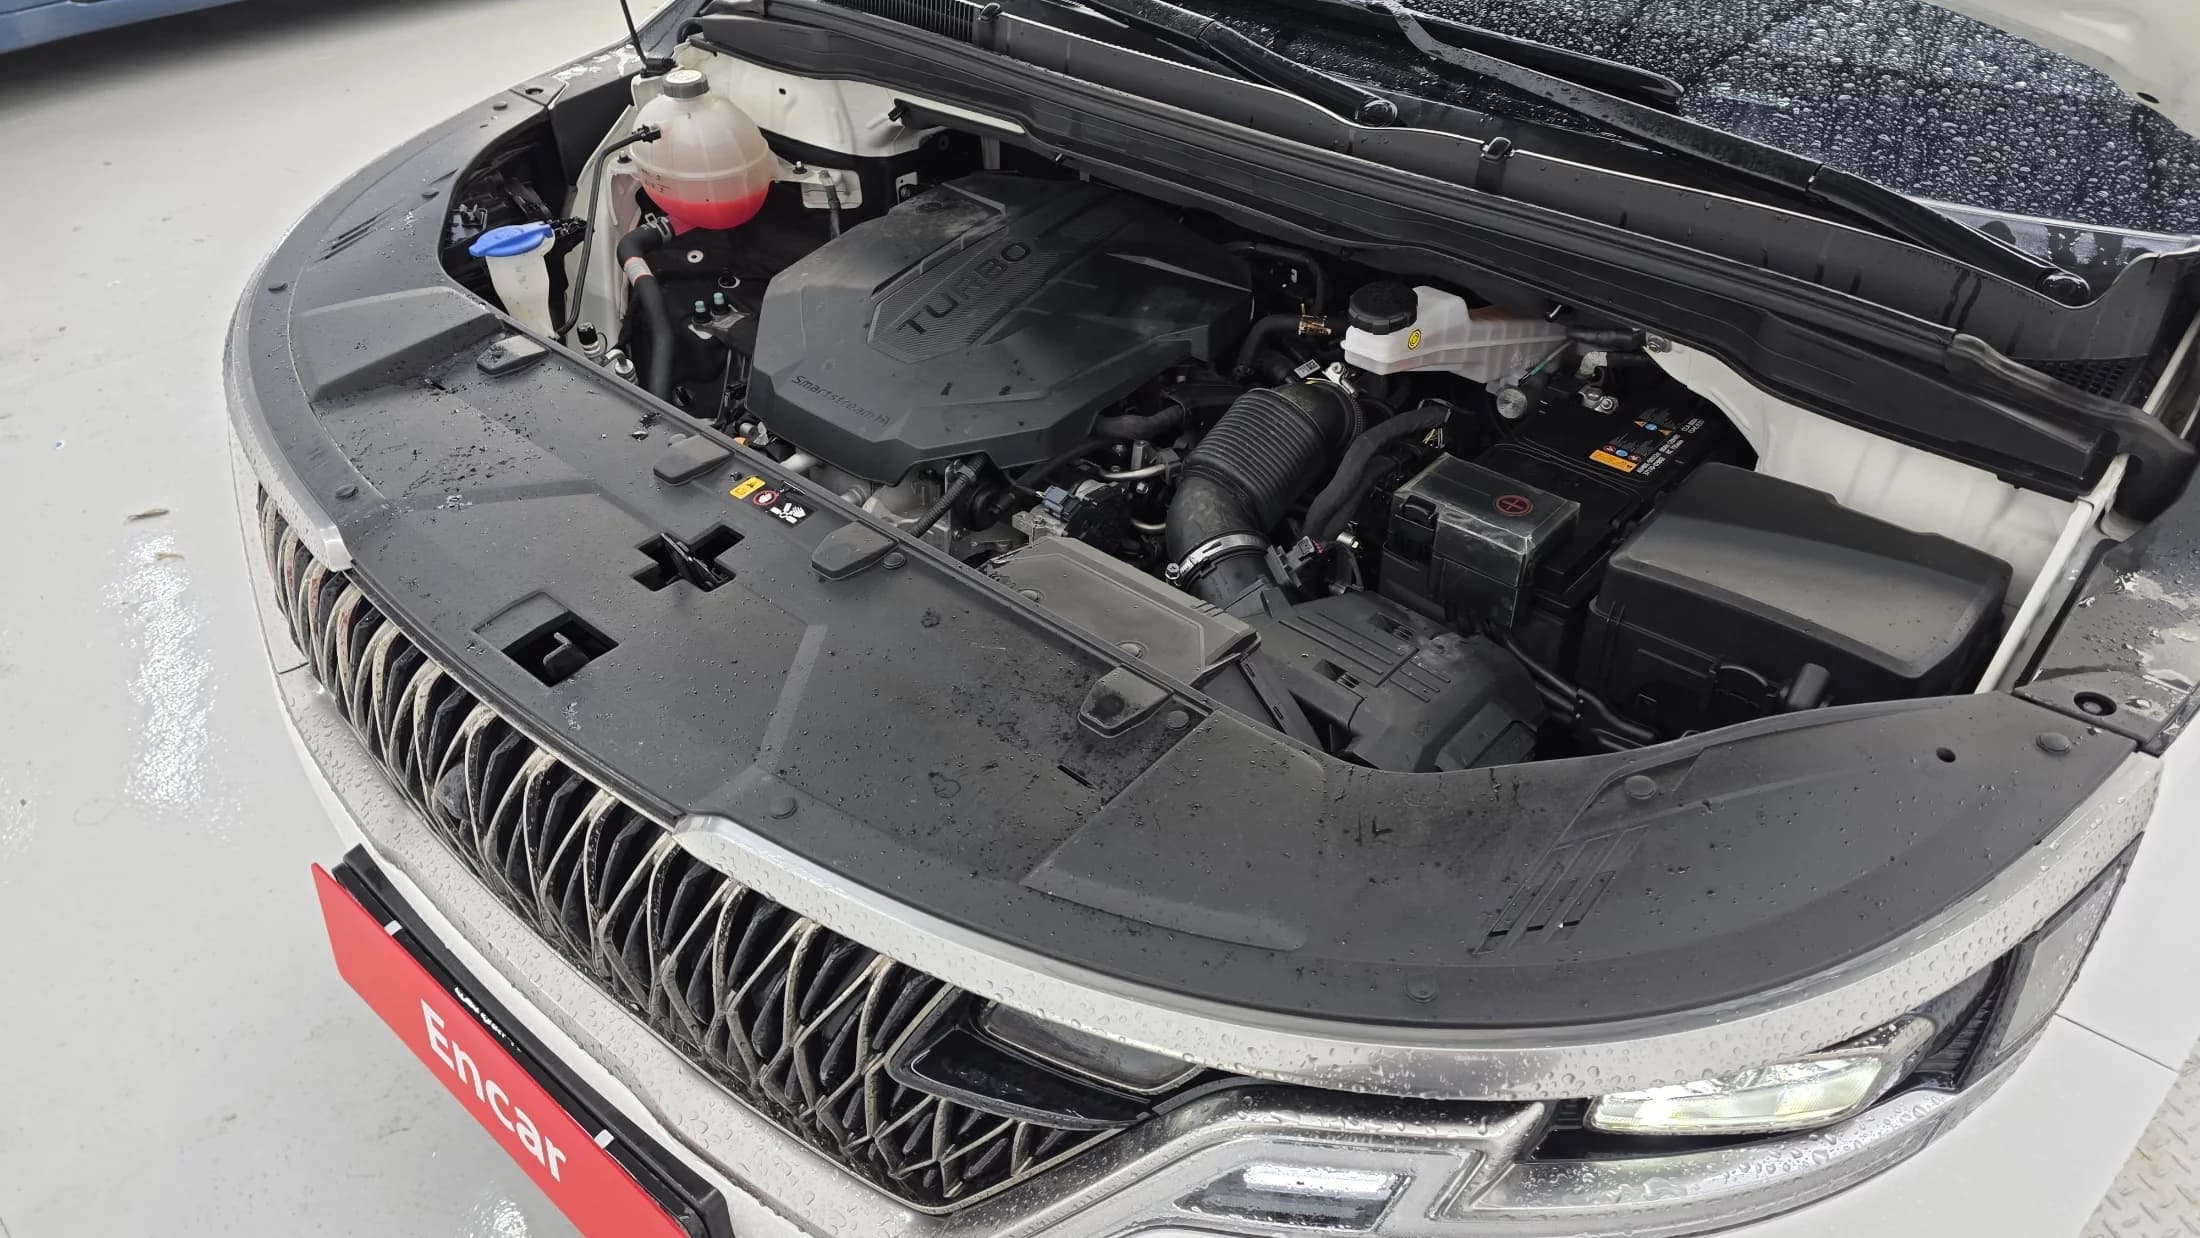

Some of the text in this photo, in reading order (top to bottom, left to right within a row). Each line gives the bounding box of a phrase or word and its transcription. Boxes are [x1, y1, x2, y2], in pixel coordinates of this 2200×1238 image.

[896, 241, 1032, 335] TURBO
[791, 375, 875, 421] Smartstream
[420, 997, 567, 1182] Encar
